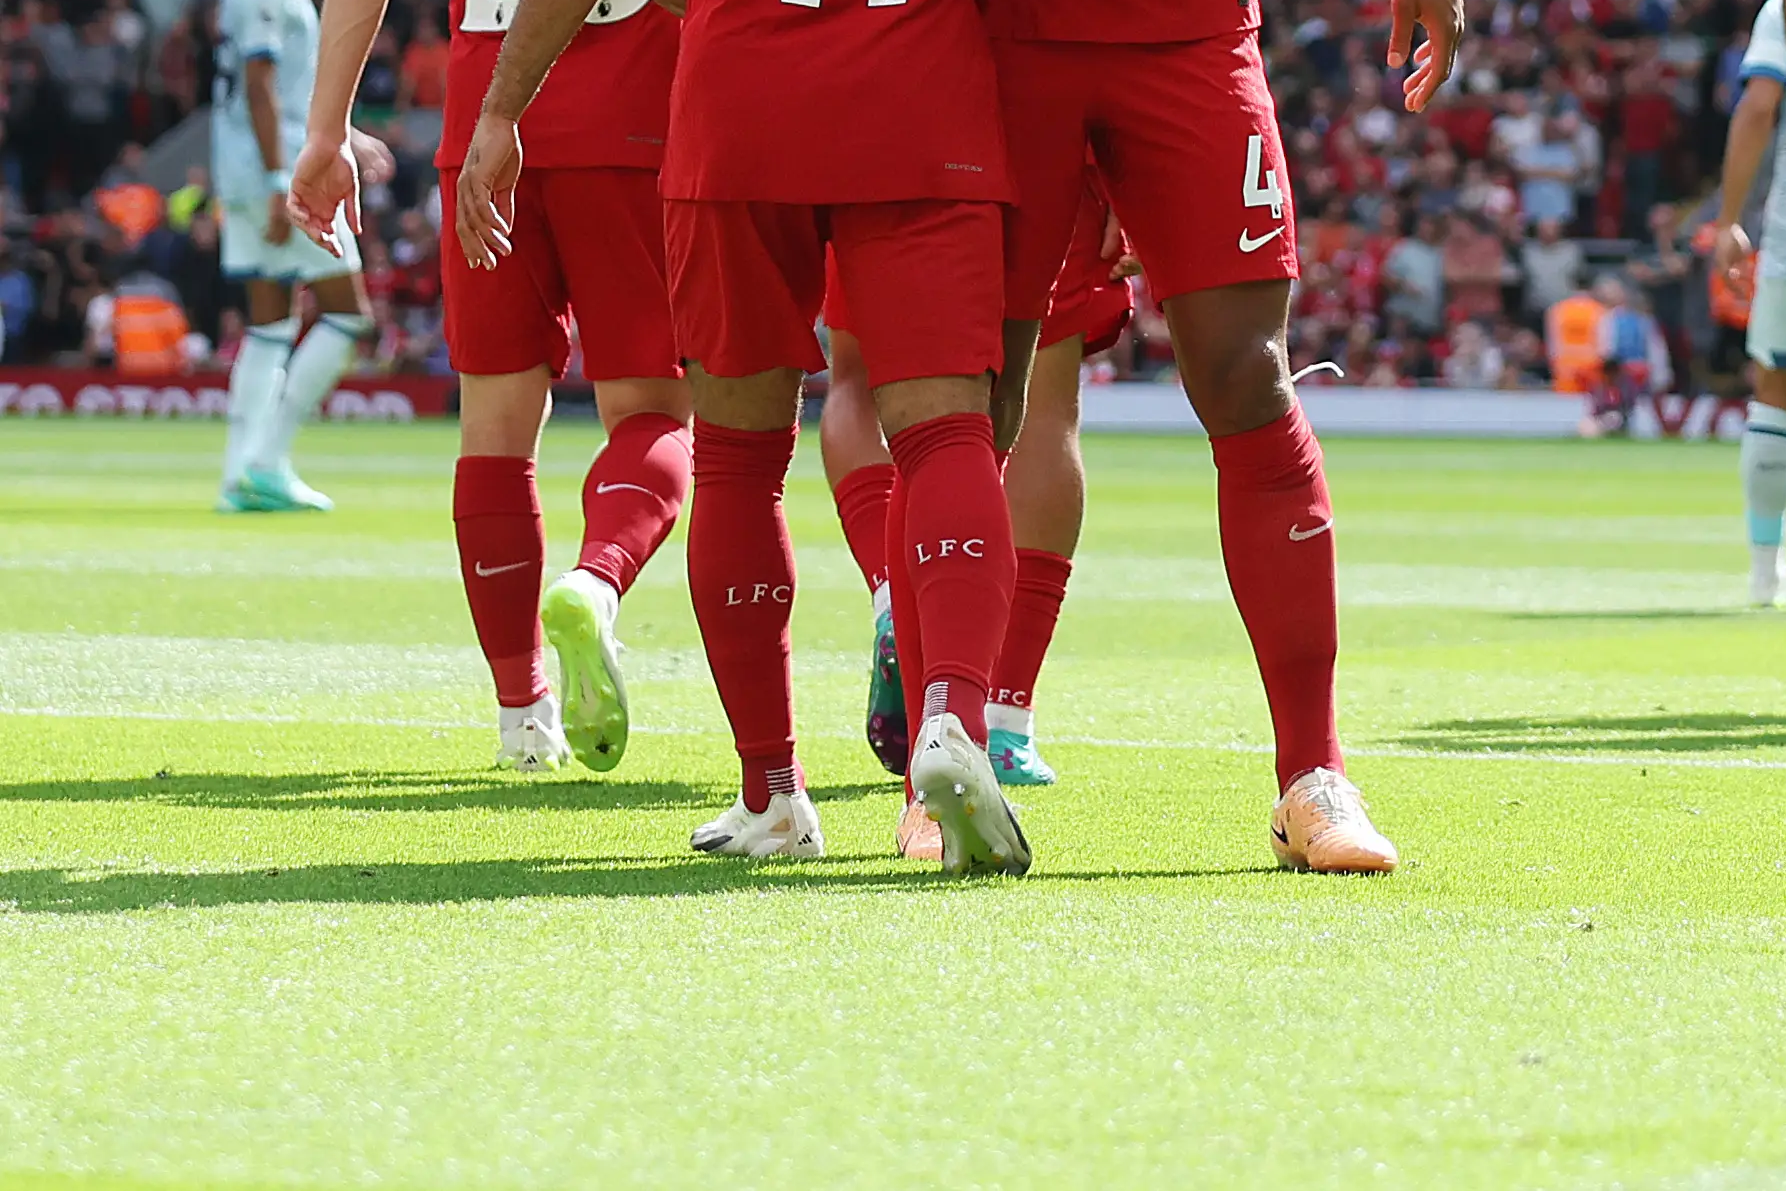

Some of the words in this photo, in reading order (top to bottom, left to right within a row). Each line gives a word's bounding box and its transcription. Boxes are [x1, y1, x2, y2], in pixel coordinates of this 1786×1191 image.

[1241, 135, 1283, 219] 4
[915, 538, 984, 565] LFC
[724, 582, 792, 607] LFC
